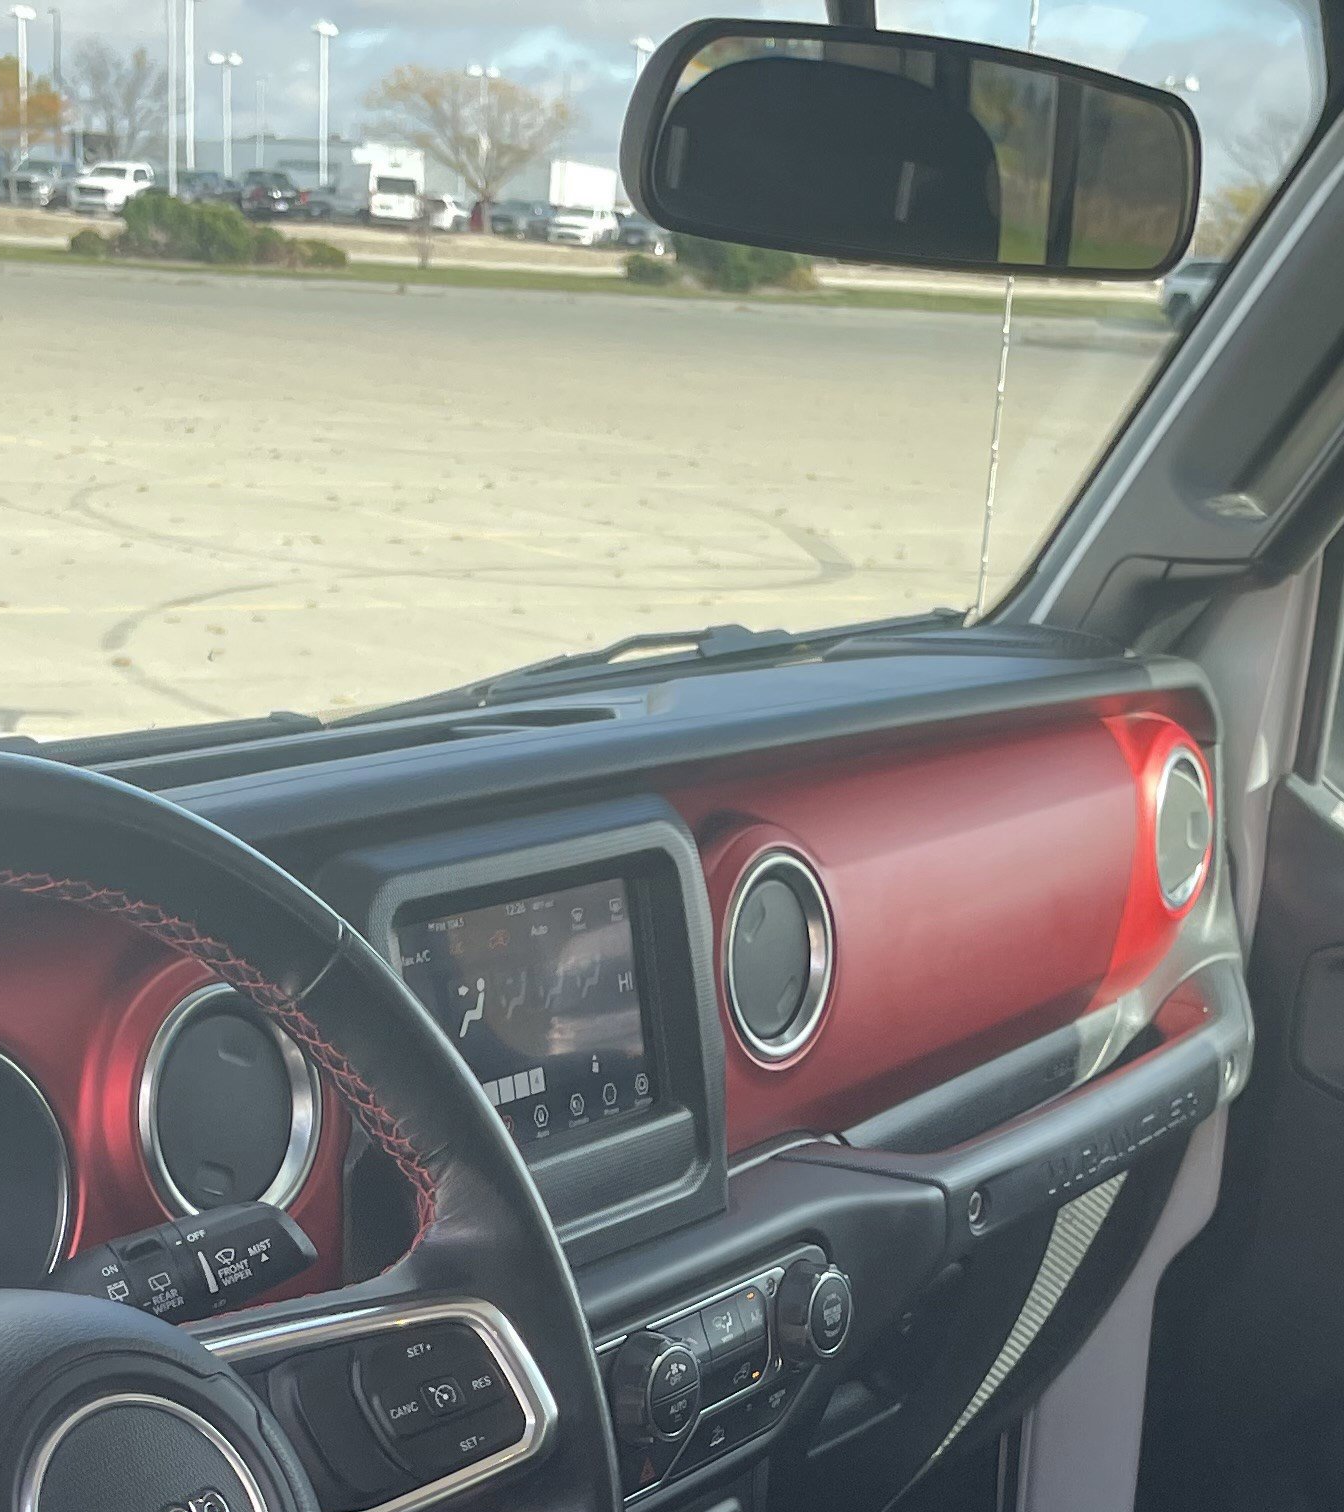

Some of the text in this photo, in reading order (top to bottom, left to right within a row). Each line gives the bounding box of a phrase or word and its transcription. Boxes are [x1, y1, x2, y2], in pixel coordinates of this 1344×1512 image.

[186, 1229, 206, 1244] OFF
[247, 1238, 272, 1257] MIST
[101, 1263, 119, 1278] ON
[217, 1258, 250, 1279] FRONT
[221, 1269, 254, 1288] WIPER
[152, 1287, 179, 1306] REAR
[153, 1296, 185, 1316] WIPER
[471, 1375, 492, 1391] RES
[389, 1401, 419, 1419] CANC
